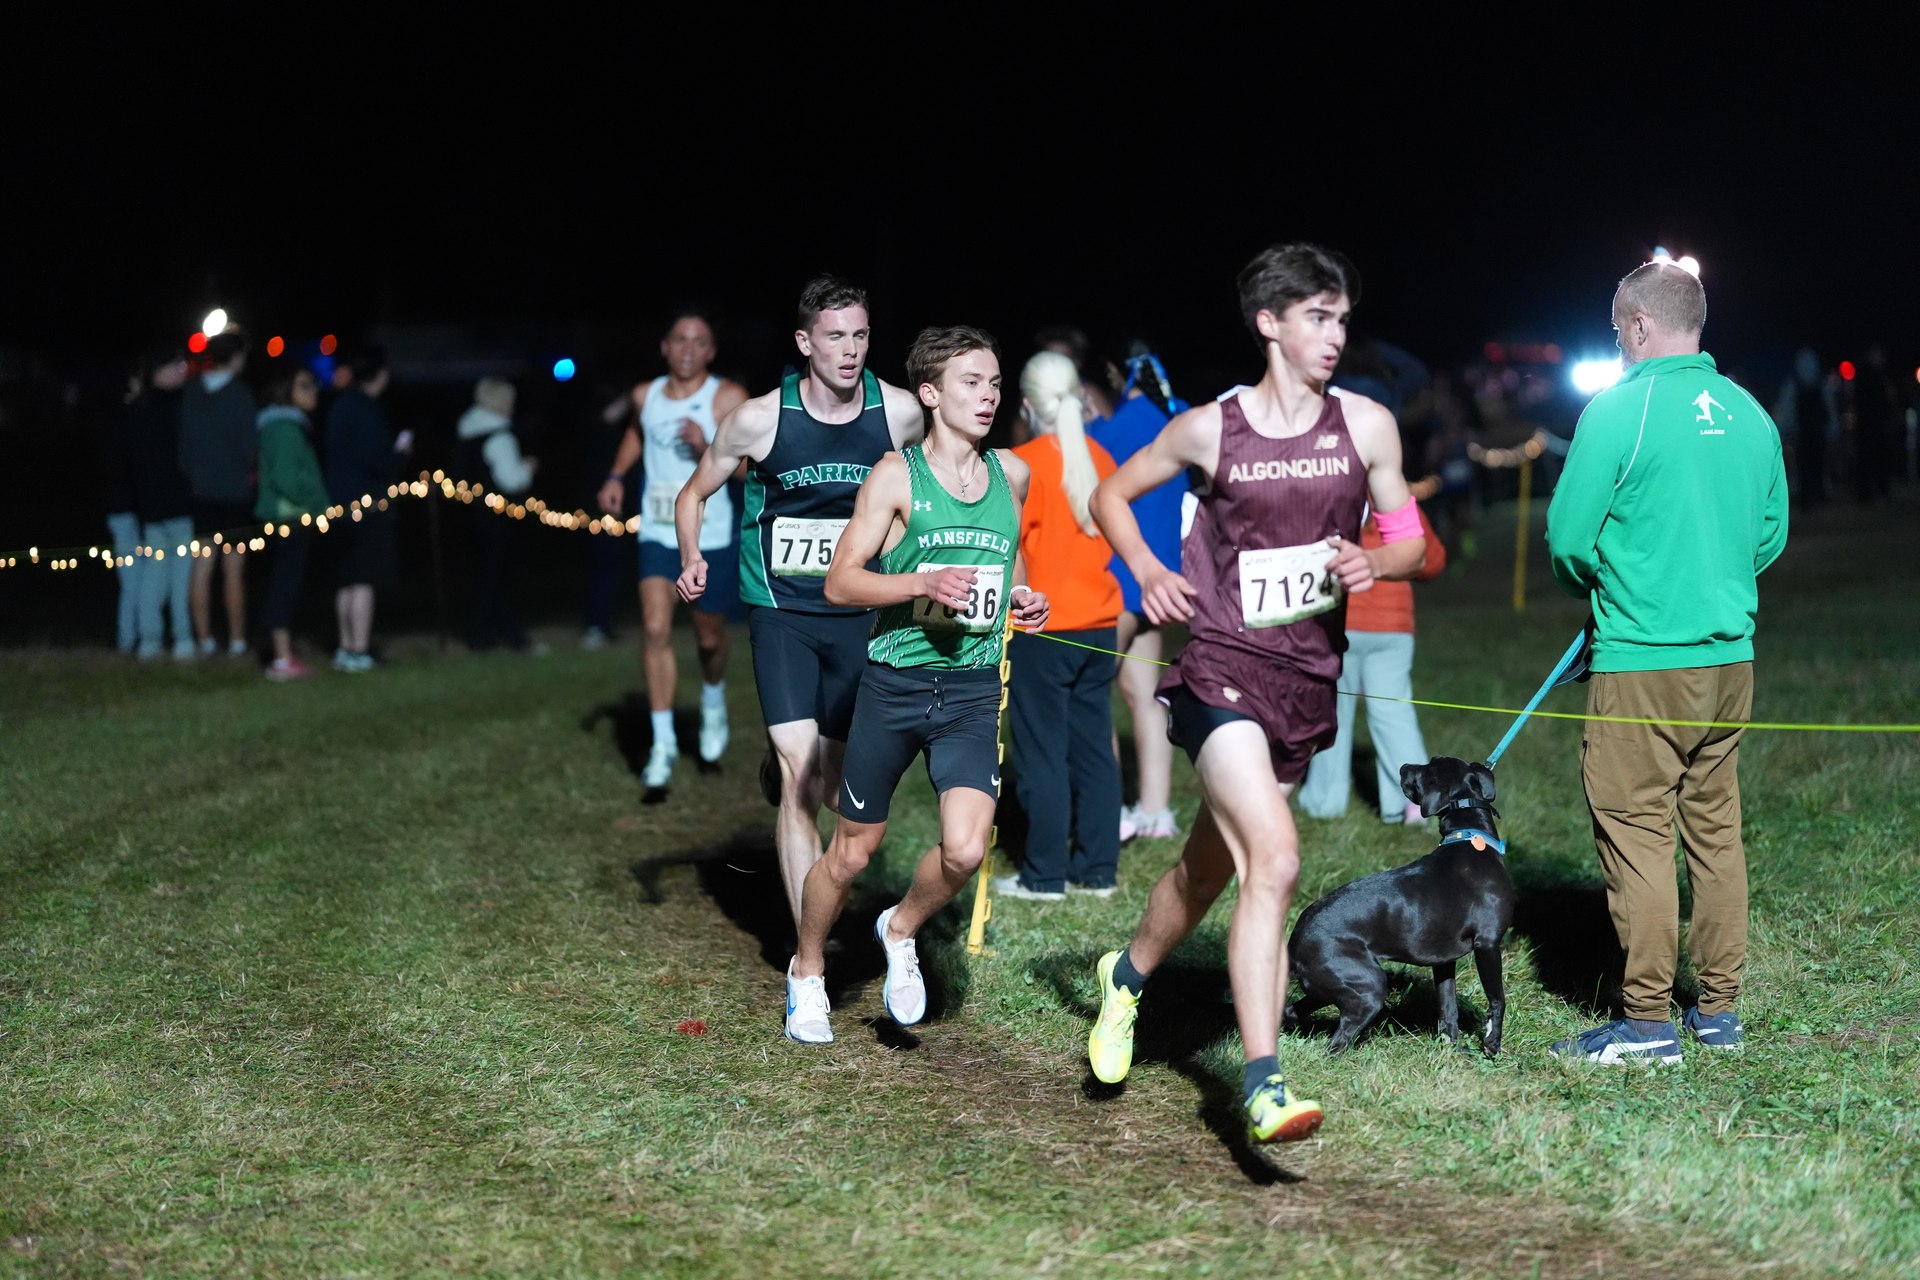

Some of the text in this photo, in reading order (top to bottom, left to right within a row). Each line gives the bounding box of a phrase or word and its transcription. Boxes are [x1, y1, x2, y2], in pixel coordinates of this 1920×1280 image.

[1228, 456, 1349, 483] ALGONQUIN
[780, 538, 832, 566] 775
[917, 531, 1010, 554] MANSFIELD
[1251, 571, 1334, 613] 7124
